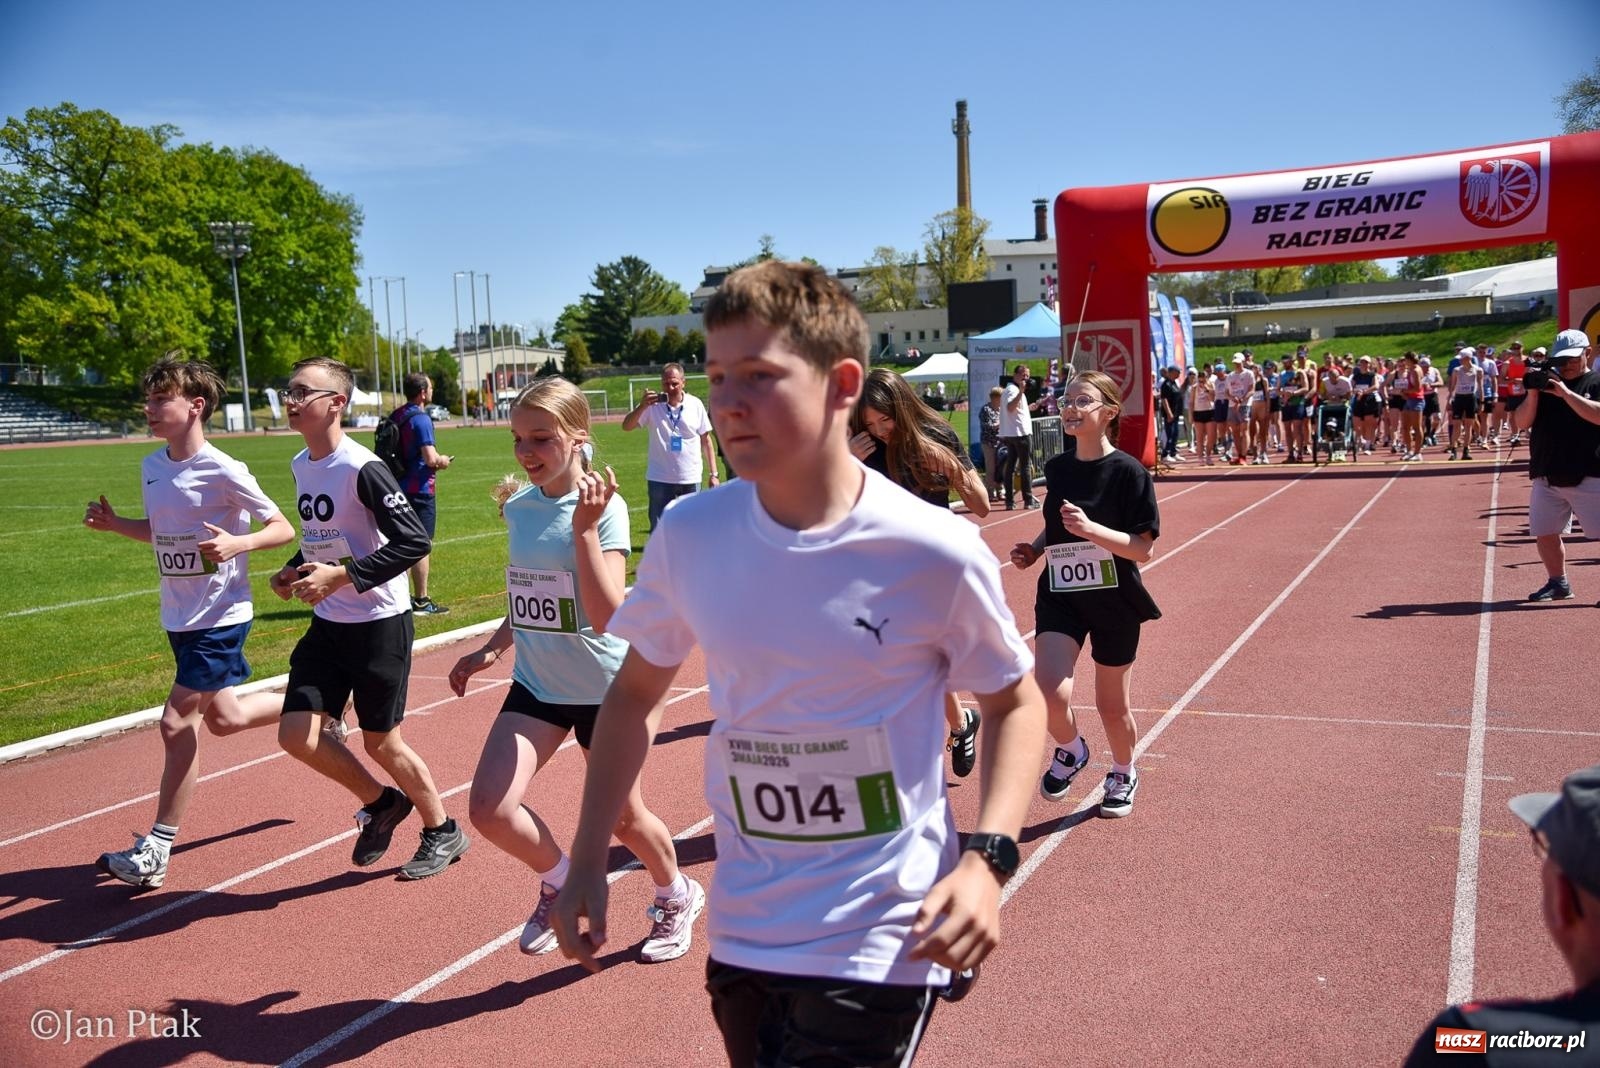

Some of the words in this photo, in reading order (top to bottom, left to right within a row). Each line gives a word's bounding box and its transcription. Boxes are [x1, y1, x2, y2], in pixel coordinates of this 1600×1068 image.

[1302, 171, 1373, 191] BIEG
[1252, 201, 1310, 224] BEZ
[1314, 190, 1427, 219] GRANIC
[1266, 221, 1411, 250] RACIBÓRZ
[298, 493, 334, 522] GO
[383, 491, 407, 508] GO
[163, 552, 196, 570] 007
[1061, 562, 1096, 582] 001
[515, 595, 556, 621] 006
[728, 739, 752, 752] XVIII
[754, 741, 778, 754] BIEG
[781, 742, 801, 755] BEZ
[804, 739, 848, 754] GRANIC
[731, 751, 790, 767] 3MAJA2026
[754, 782, 845, 824] 014
